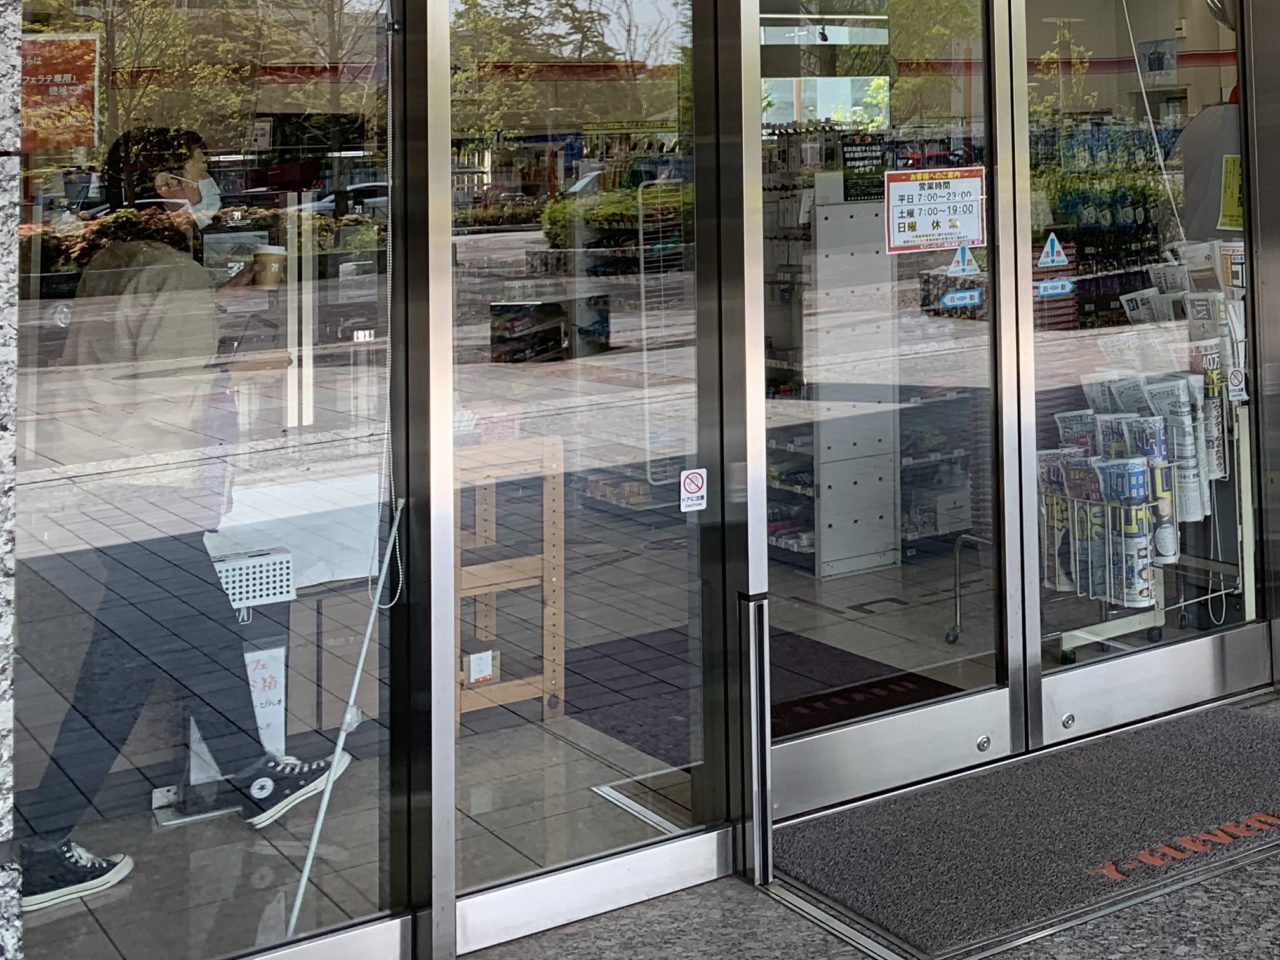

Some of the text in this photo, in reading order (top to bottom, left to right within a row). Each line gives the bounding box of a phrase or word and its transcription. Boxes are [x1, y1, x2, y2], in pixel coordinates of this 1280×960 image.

[919, 181, 951, 191] 営業時間
[898, 194, 914, 204] 平日
[898, 209, 915, 219] 土曜
[898, 221, 917, 233] 日曜
